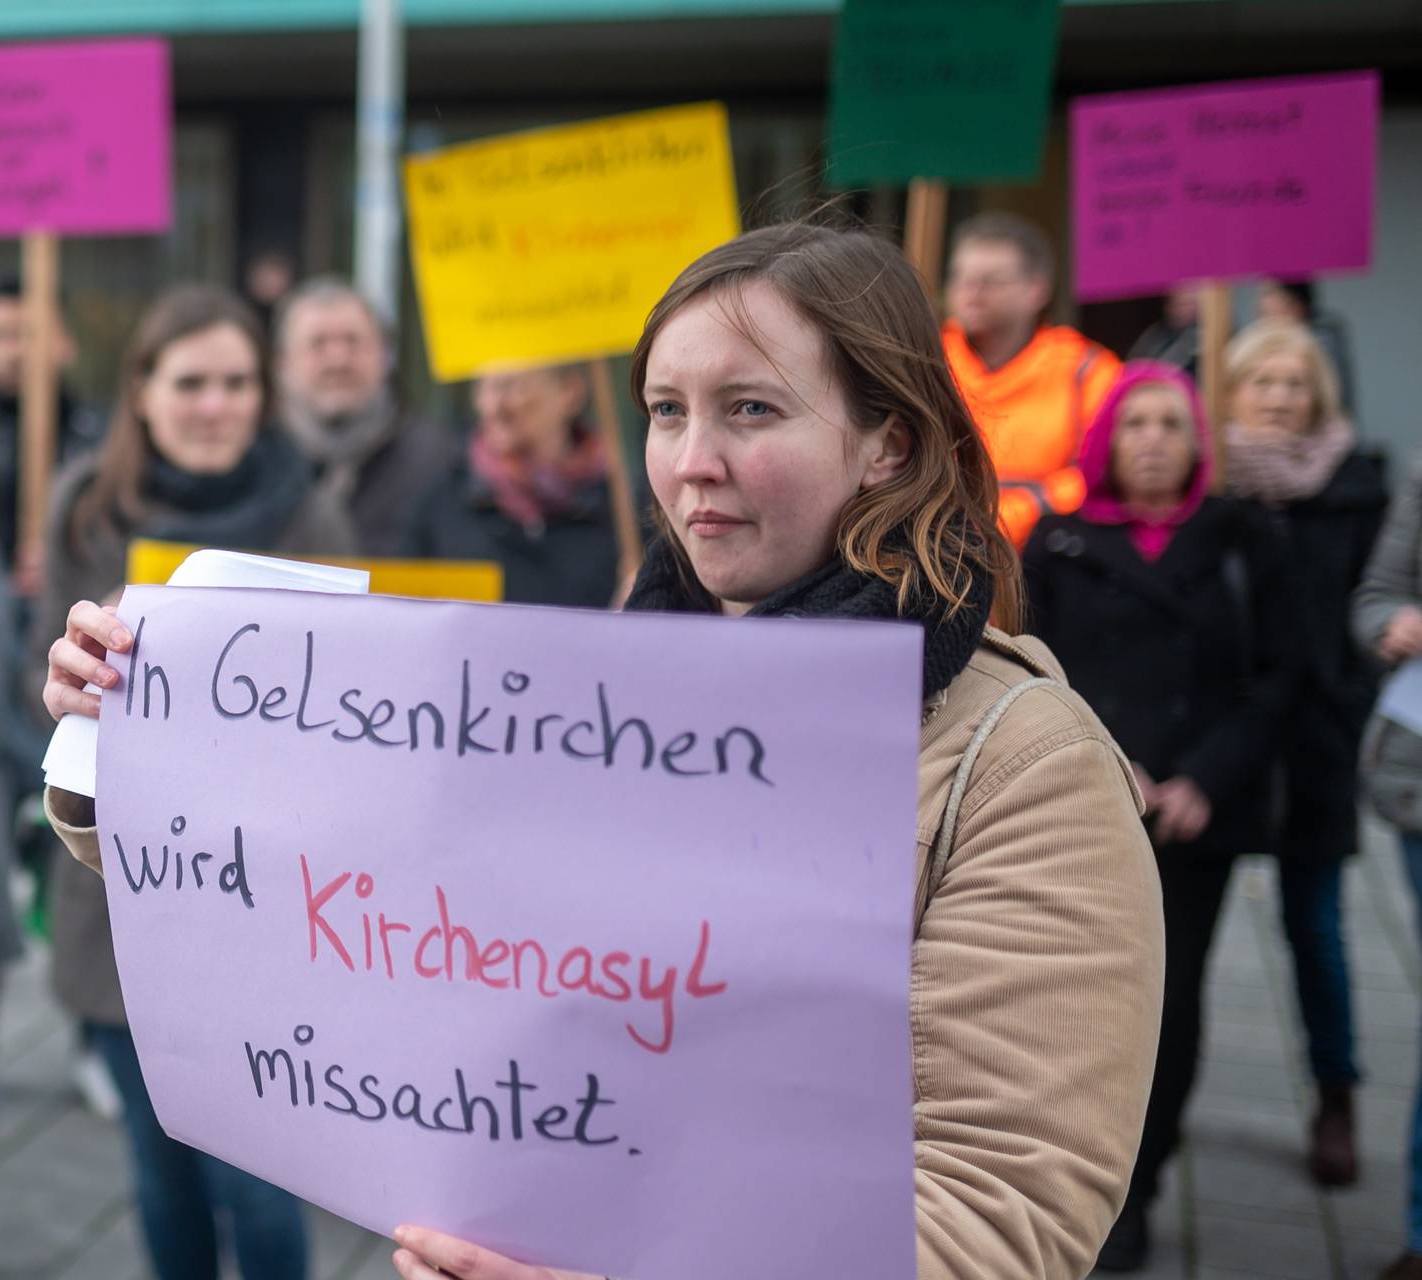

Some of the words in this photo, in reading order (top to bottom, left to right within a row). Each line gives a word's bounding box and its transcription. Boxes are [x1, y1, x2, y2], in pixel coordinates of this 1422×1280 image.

[126, 616, 170, 720] In
[211, 623, 774, 786] Gelsenkirchen
[114, 815, 255, 908] wird
[300, 854, 727, 1054] Kirchenasyl
[245, 1025, 643, 1156] missachtet.
